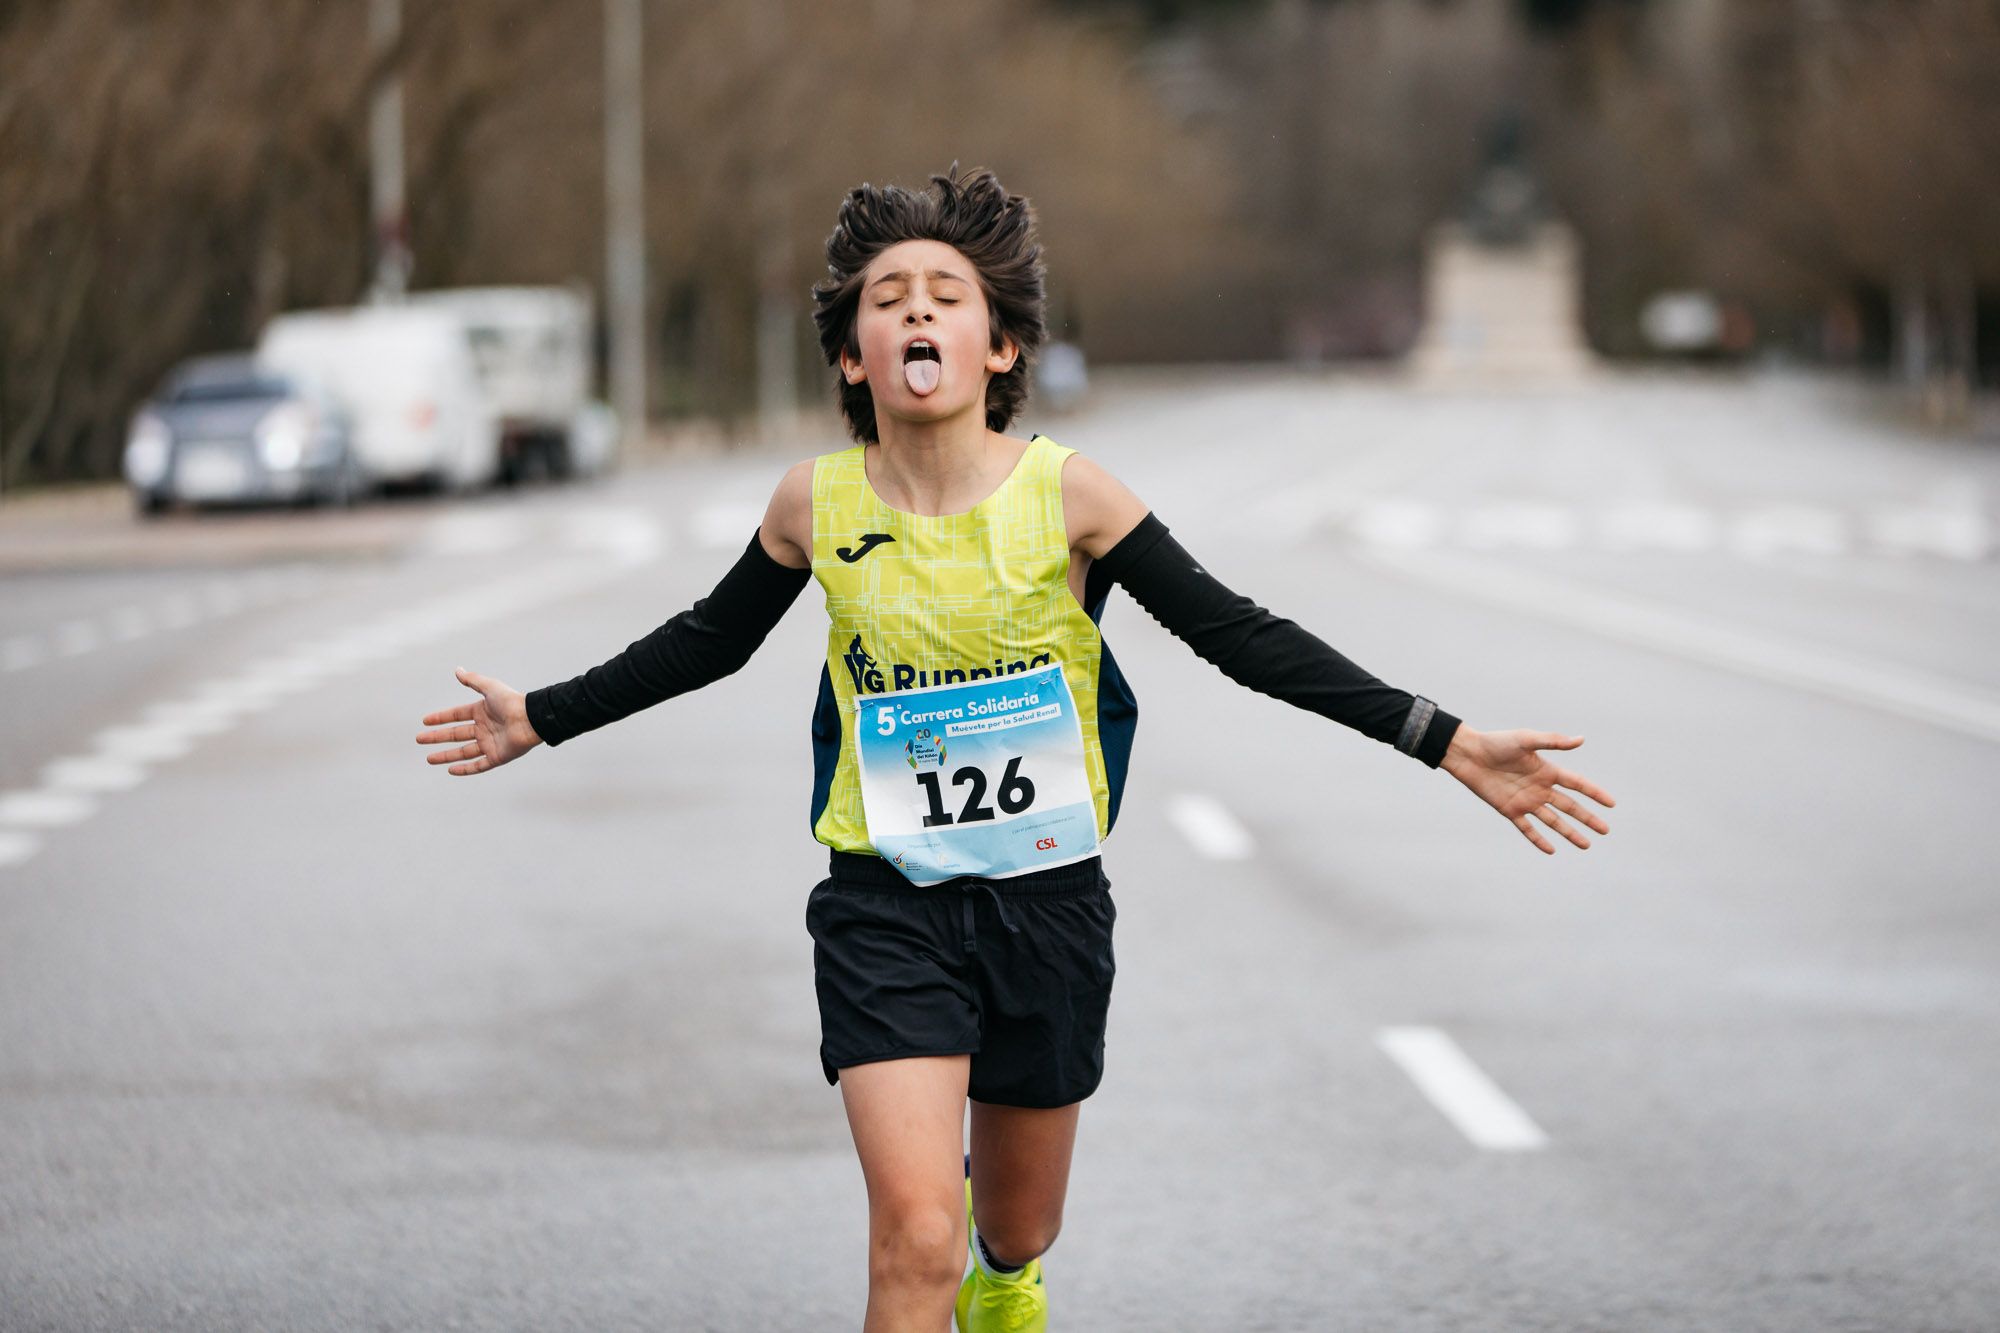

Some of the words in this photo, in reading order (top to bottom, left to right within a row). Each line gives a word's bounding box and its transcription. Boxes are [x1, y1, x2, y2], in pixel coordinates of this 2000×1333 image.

[900, 707, 964, 725] Carrera
[967, 692, 1040, 716] Solidaria
[988, 721, 1001, 732] por
[1003, 718, 1011, 726] la
[1013, 712, 1035, 723] Salud
[1037, 706, 1058, 717] Renal
[916, 756, 1035, 827] 126
[1036, 837, 1058, 851] CSL
